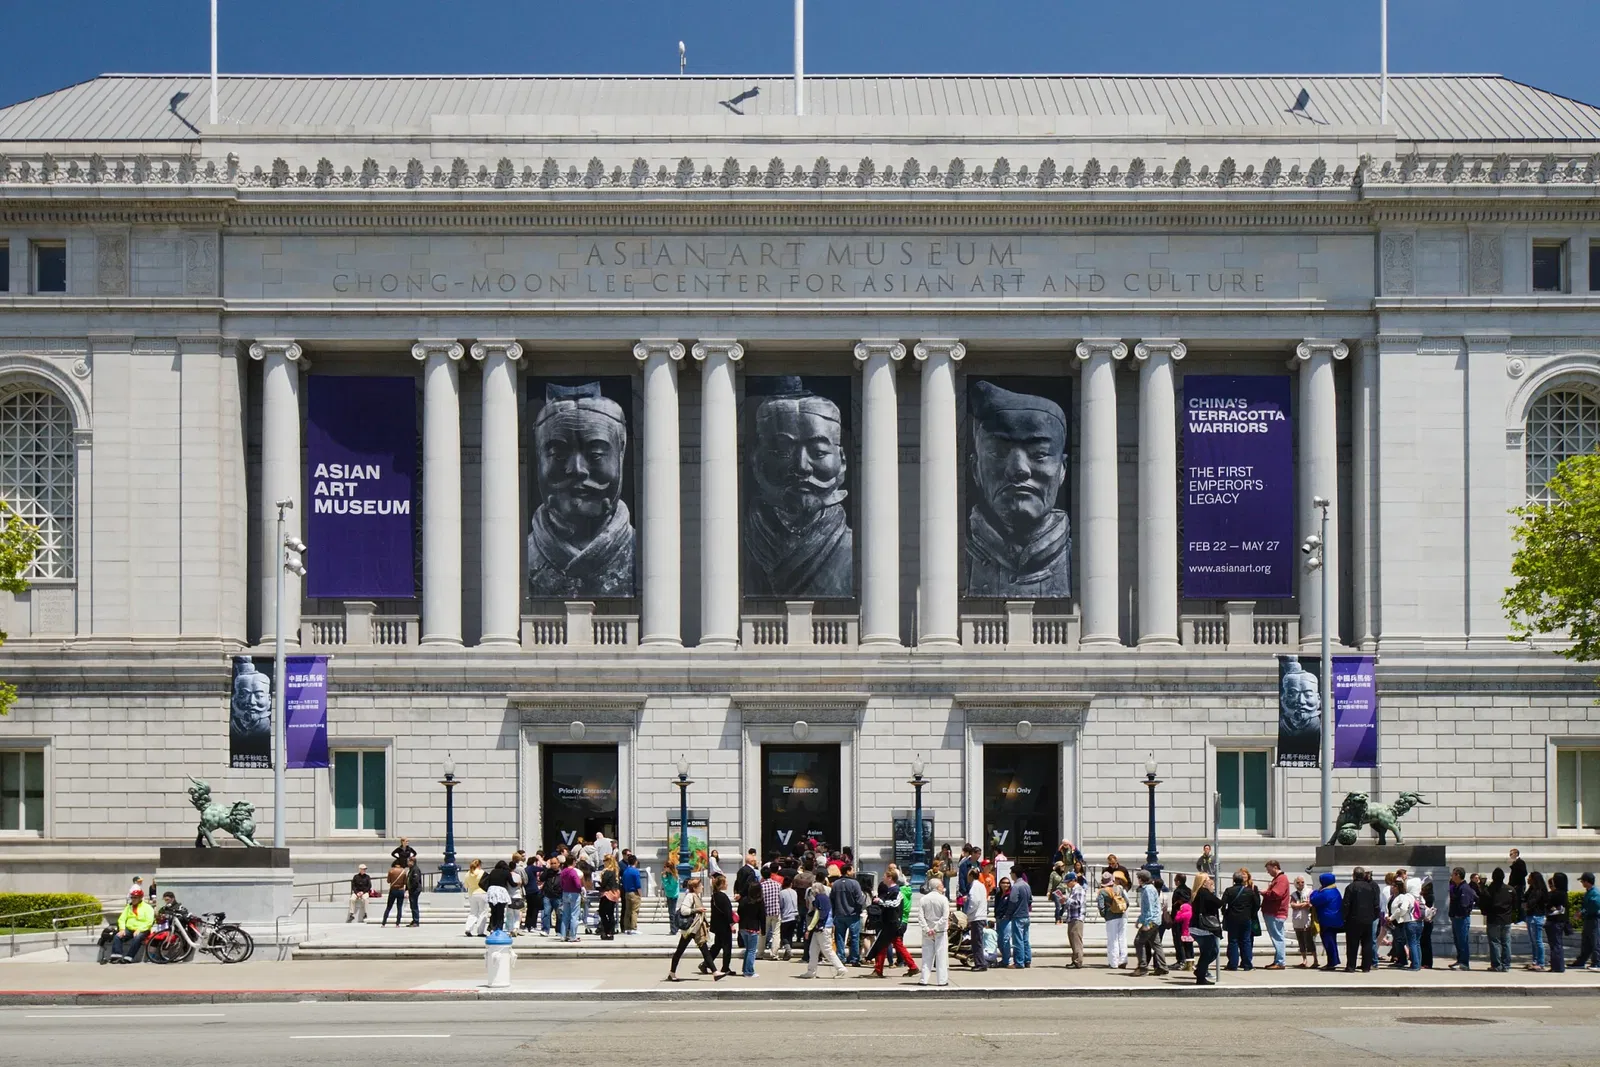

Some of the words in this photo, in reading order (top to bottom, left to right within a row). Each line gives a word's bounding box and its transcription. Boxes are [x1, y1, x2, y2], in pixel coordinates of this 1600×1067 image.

[585, 241, 707, 266] ASIAN
[729, 242, 806, 266] ART
[827, 241, 1015, 266] MUSEUM
[332, 273, 567, 293] CHONG-MOON
[587, 274, 634, 293] LEE
[652, 273, 772, 293] CENTER
[789, 273, 848, 293] FOR
[862, 273, 955, 293] ASIAN
[970, 274, 1026, 293] ART
[1043, 273, 1106, 293] AND
[1124, 273, 1265, 293] CULTURE
[1189, 398, 1248, 409] CHINA'S
[1189, 410, 1286, 421] TERRACOTTA
[1189, 422, 1269, 433] WARRIORS
[314, 463, 380, 480] ASIAN
[1189, 467, 1214, 478] THE
[1218, 466, 1254, 477] FIRST
[314, 481, 358, 497] ART
[1189, 479, 1264, 491] EMPEROR'S
[1189, 493, 1240, 505] LEGACY
[314, 498, 410, 515] MUSEUM
[1189, 541, 1210, 552] FEB
[1212, 541, 1227, 551] 22
[1242, 541, 1264, 551] MAY
[1266, 541, 1280, 551] 27
[1189, 562, 1272, 575] www.asianart.org
[558, 787, 582, 795] Priority
[783, 786, 819, 794] Entrance
[1016, 787, 1032, 795] Only
